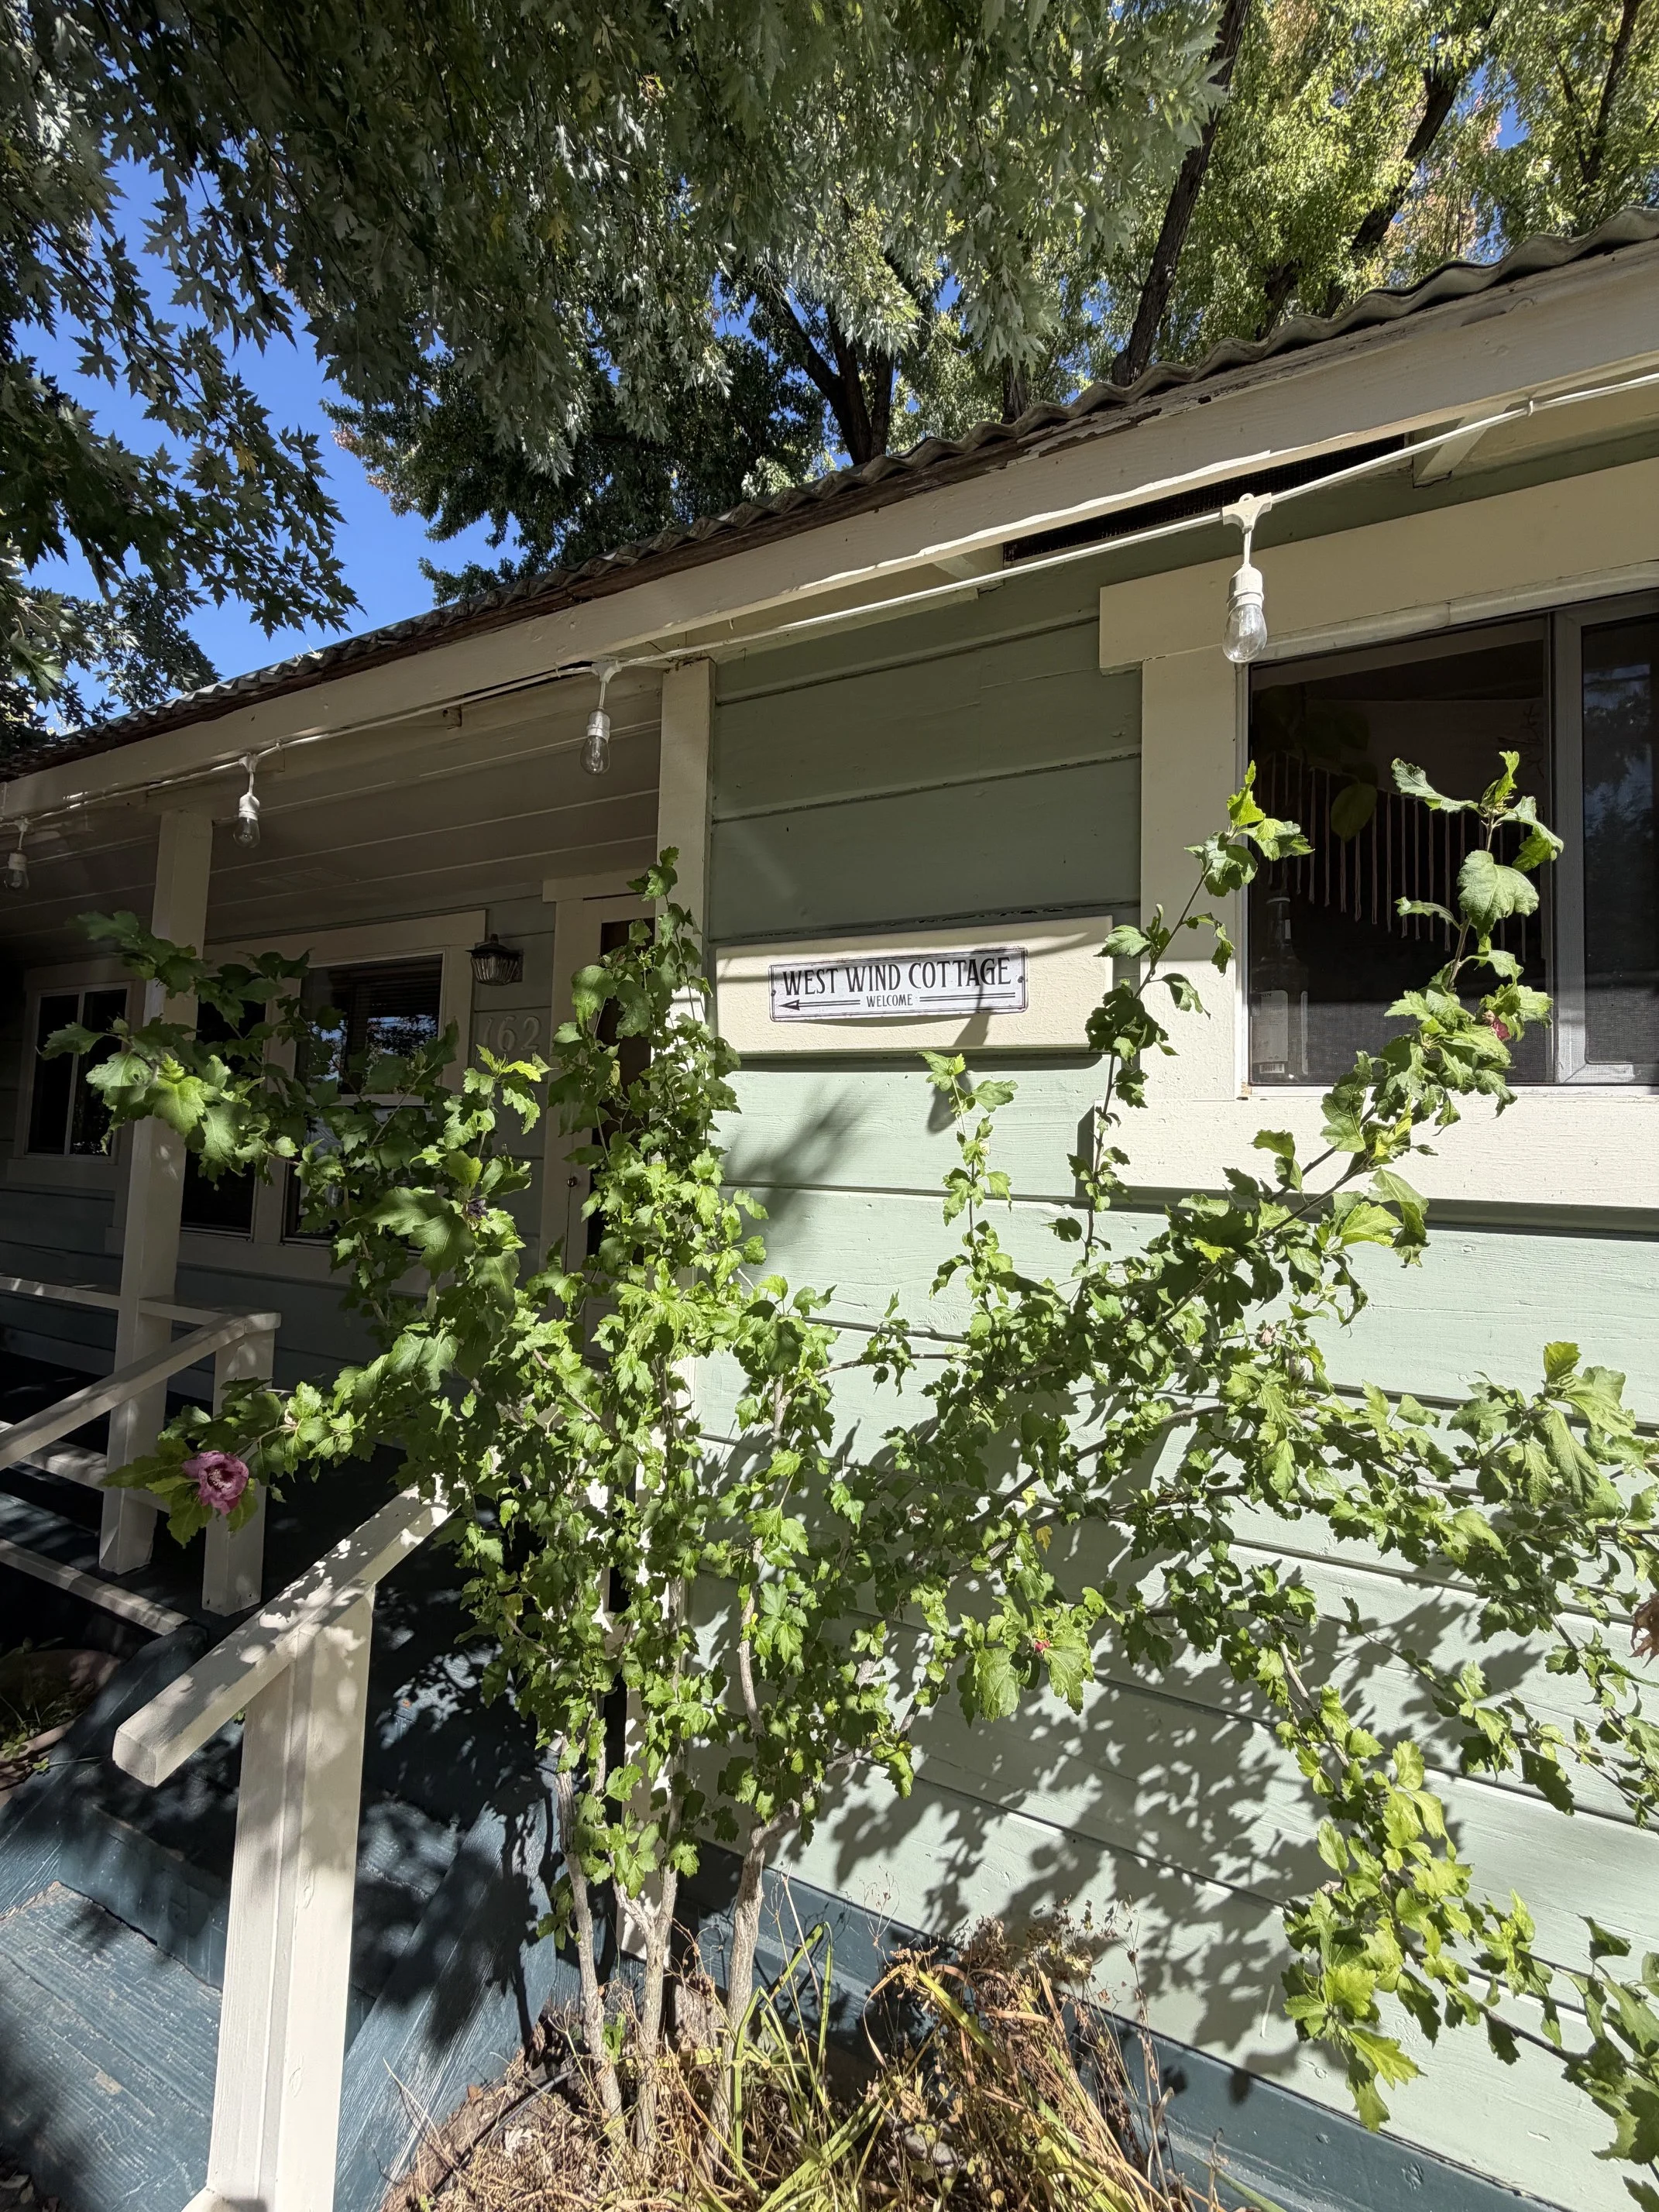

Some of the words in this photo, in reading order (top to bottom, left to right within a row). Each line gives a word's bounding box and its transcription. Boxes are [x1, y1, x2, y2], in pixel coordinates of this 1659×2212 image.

[782, 967, 839, 996] WEST
[845, 963, 901, 992] WIND
[908, 957, 1012, 989] COTTAGE
[866, 994, 913, 1008] WELCOME
[482, 1015, 541, 1052] 162
